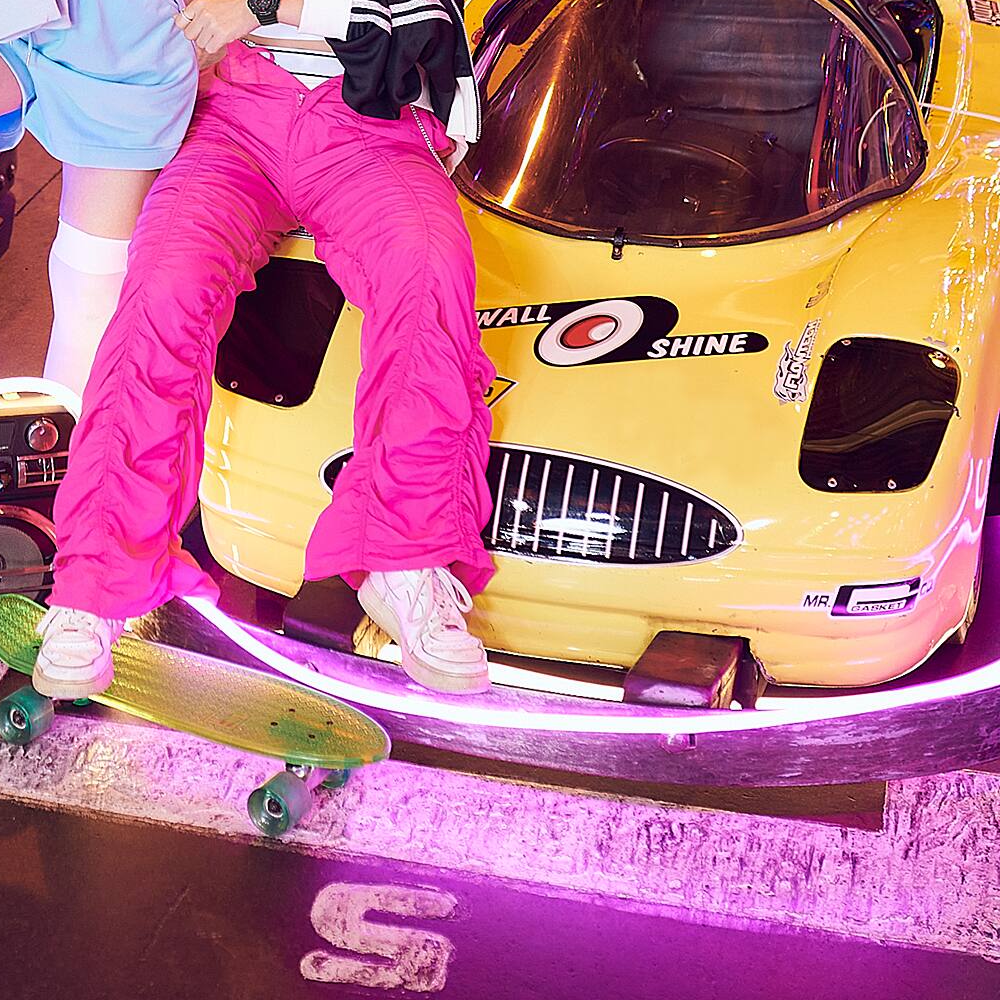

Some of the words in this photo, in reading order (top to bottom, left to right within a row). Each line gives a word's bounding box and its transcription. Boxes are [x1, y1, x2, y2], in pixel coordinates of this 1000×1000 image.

[647, 333, 748, 359] SHINE
[803, 594, 831, 608] MR.
[851, 602, 904, 612] GASKET
